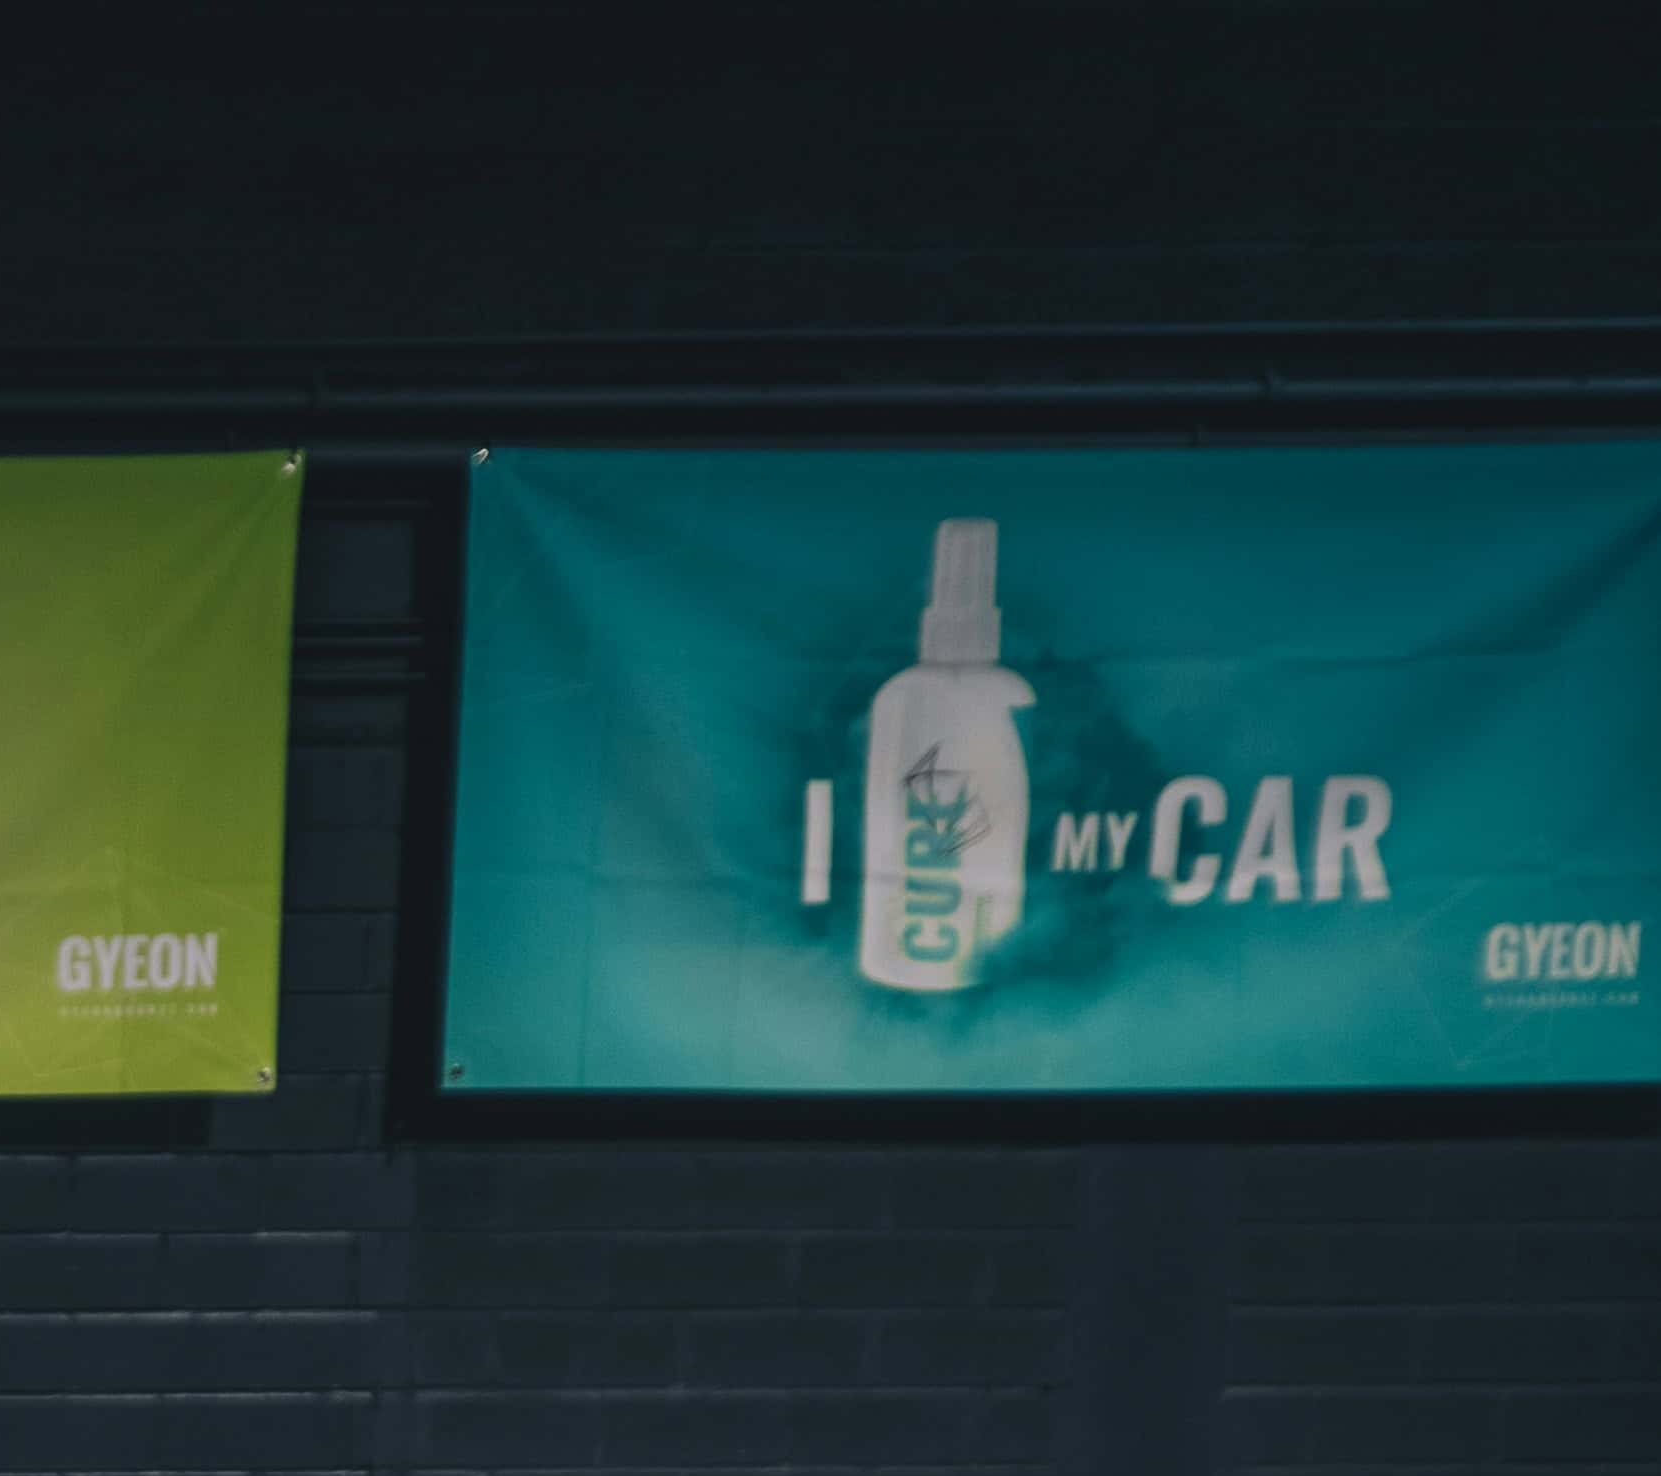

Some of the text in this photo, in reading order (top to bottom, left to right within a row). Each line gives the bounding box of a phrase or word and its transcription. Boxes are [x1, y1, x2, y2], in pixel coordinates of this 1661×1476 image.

[902, 788, 963, 963] CURE
[1050, 774, 1393, 905] MY CAR
[57, 932, 218, 993] GYEON
[1485, 920, 1642, 981] GYEON
